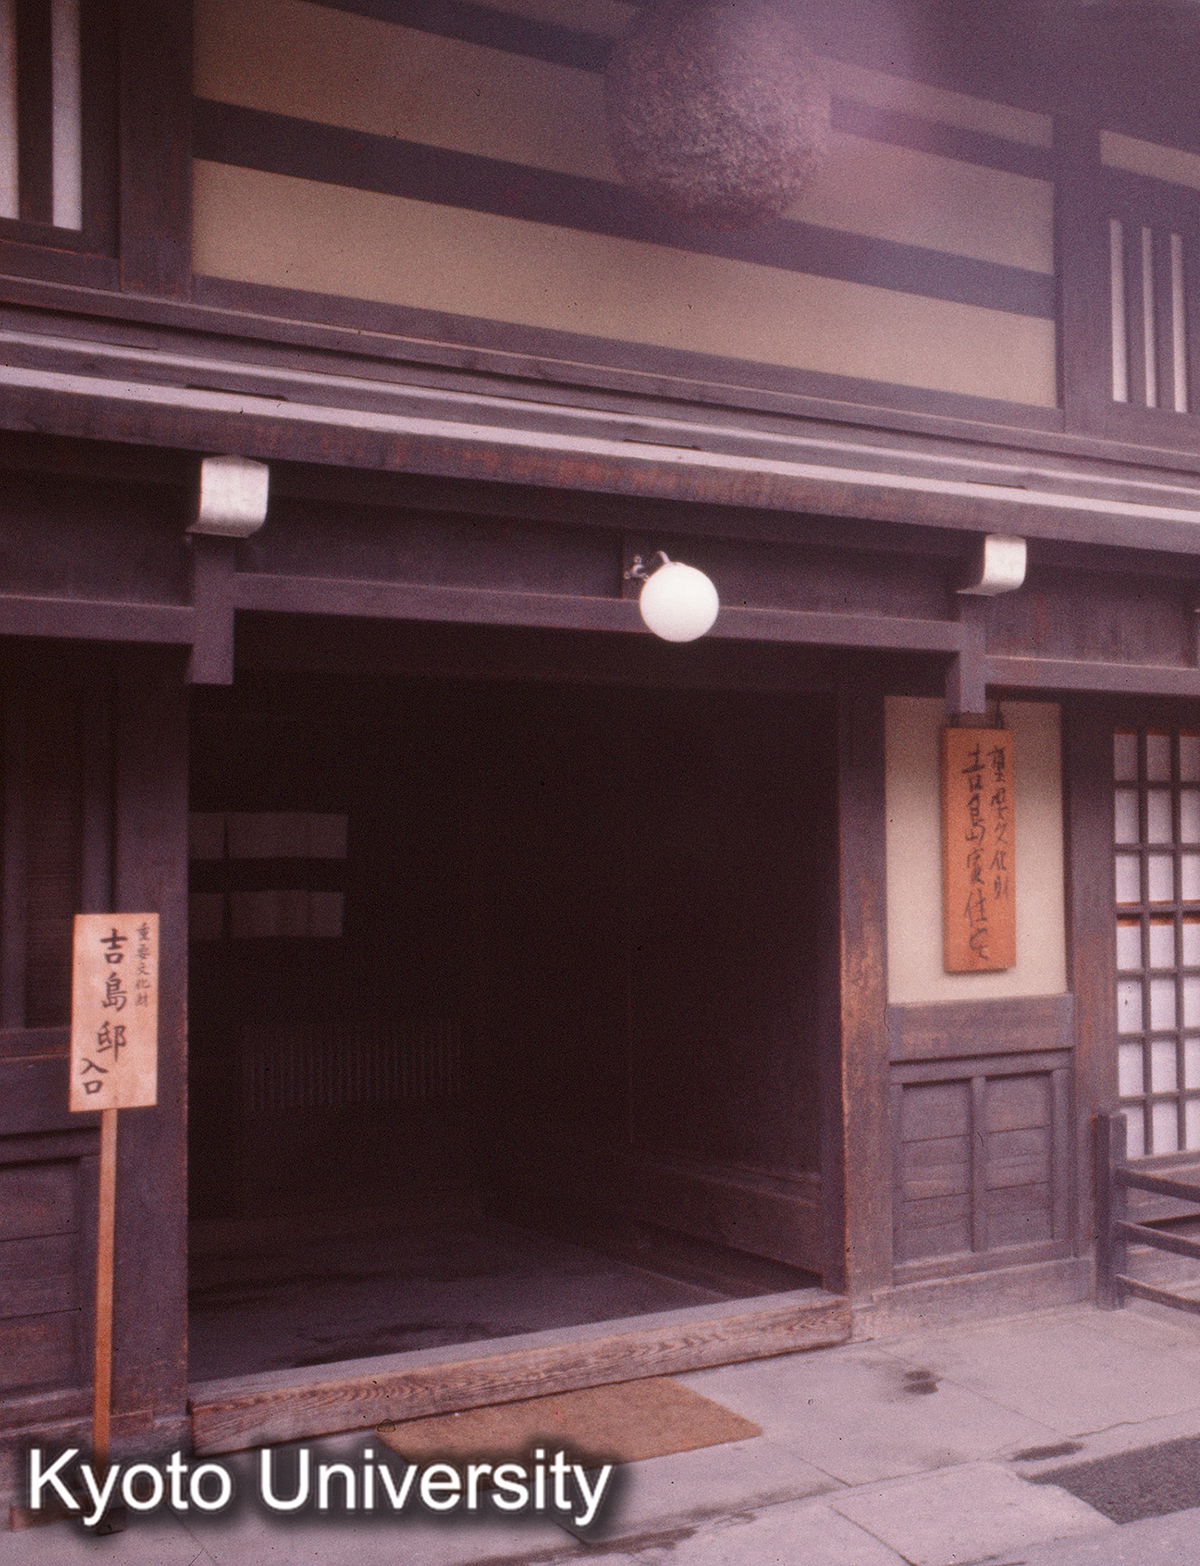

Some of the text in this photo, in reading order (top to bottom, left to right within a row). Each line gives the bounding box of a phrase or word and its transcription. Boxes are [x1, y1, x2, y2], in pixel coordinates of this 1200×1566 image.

[135, 921, 151, 1008] 重要文化財
